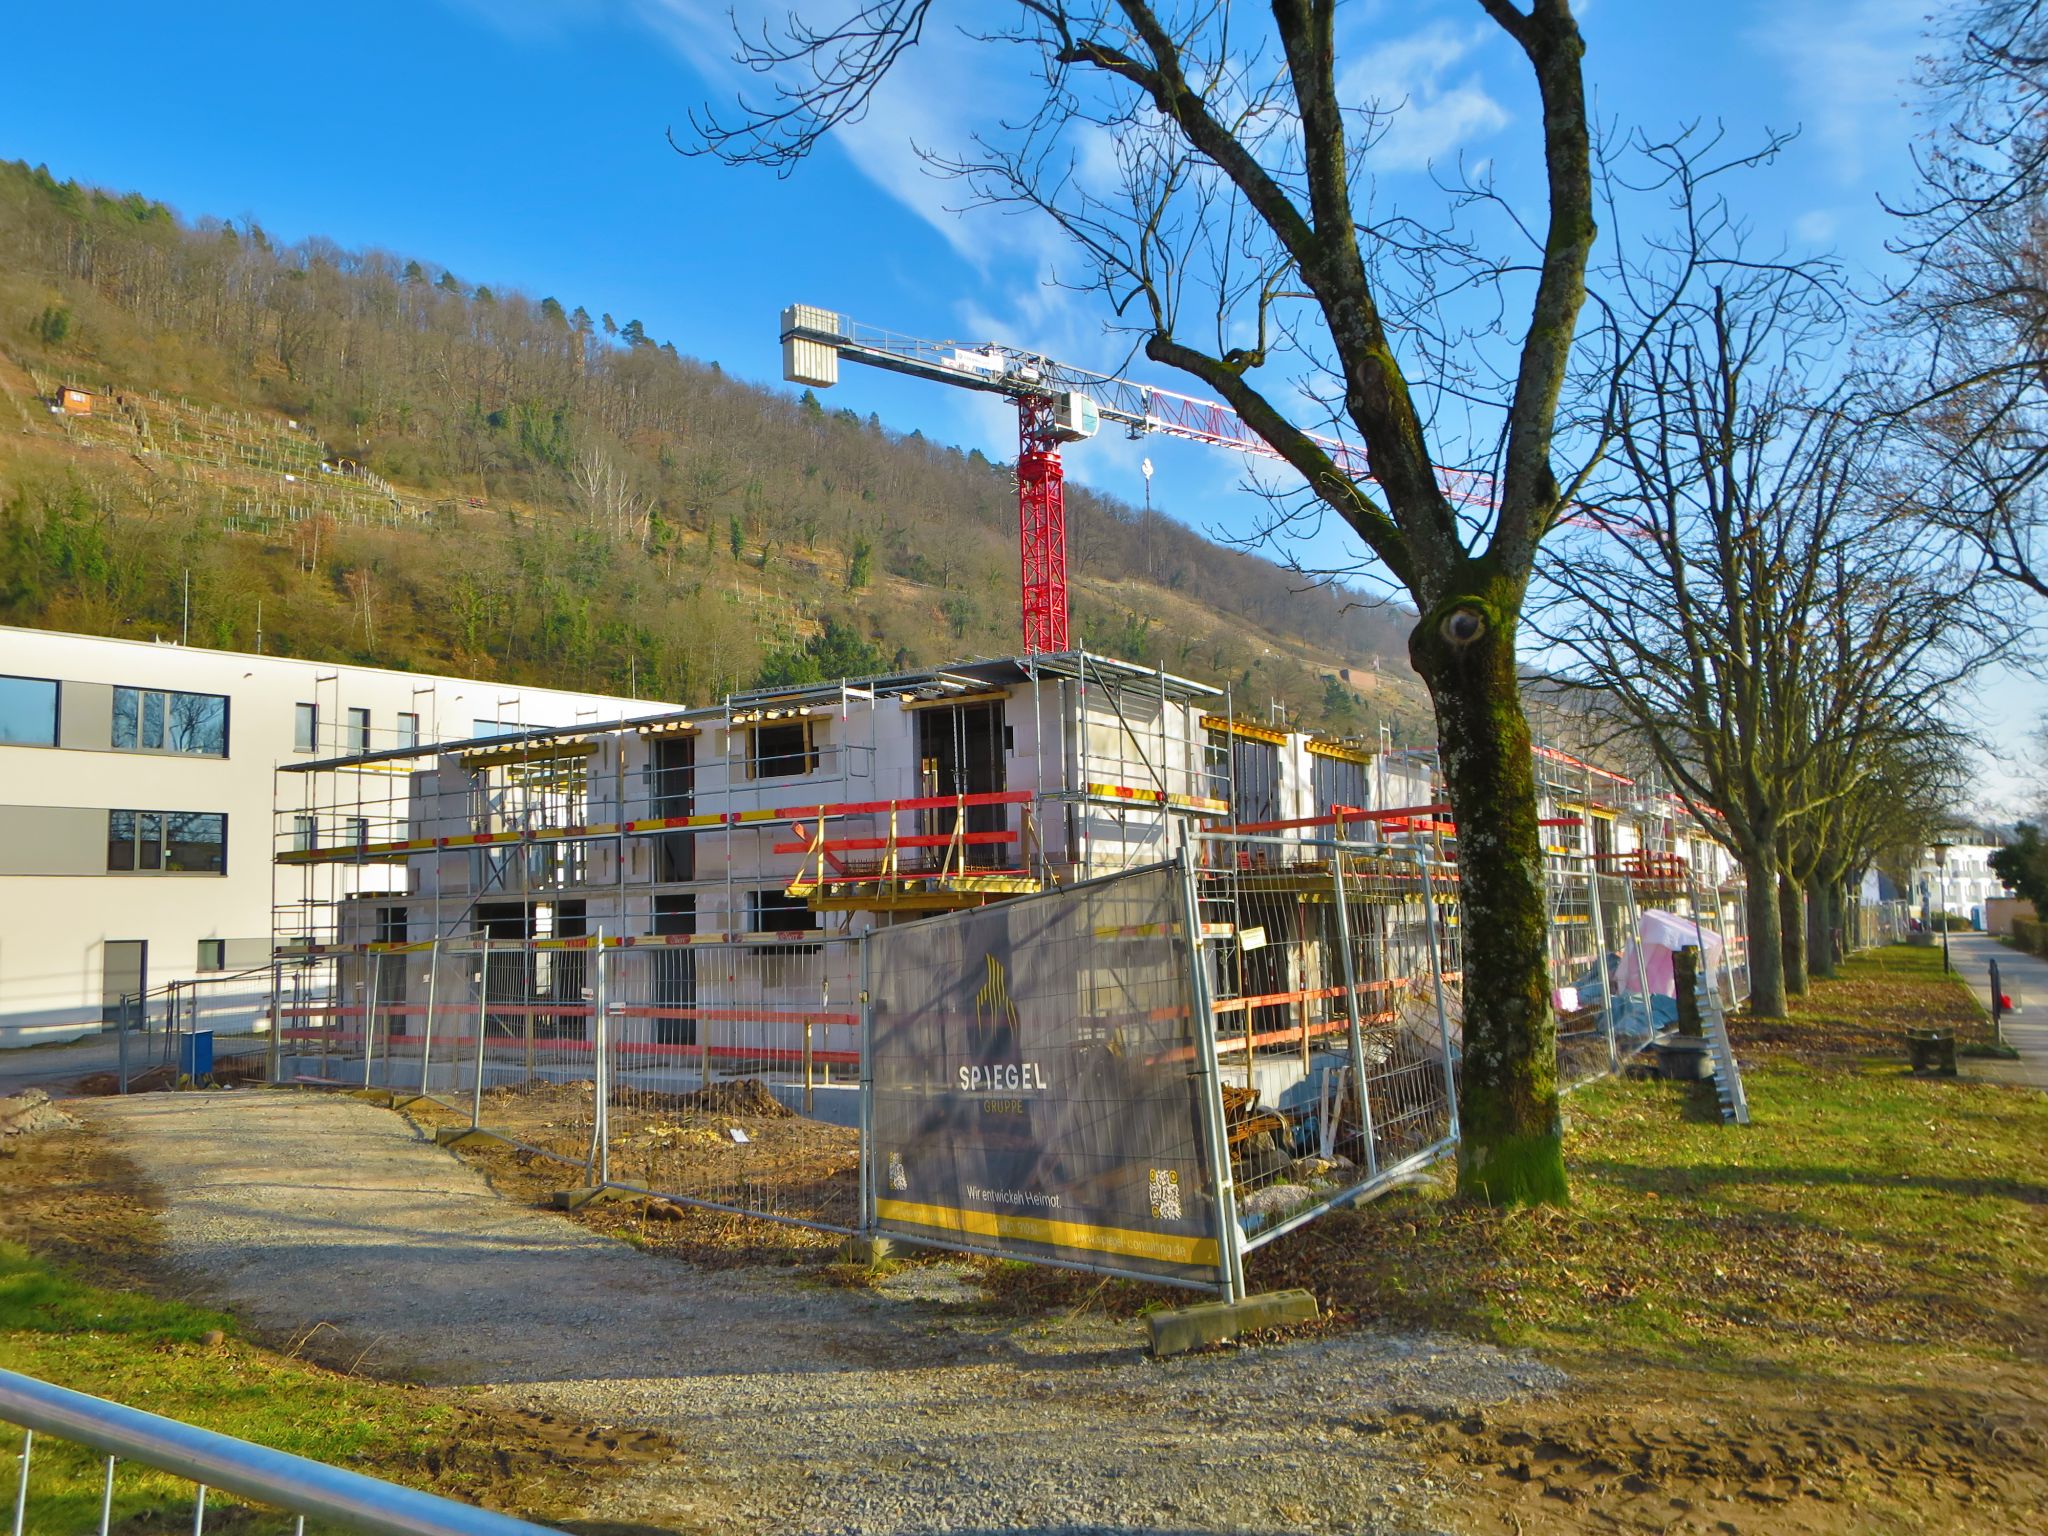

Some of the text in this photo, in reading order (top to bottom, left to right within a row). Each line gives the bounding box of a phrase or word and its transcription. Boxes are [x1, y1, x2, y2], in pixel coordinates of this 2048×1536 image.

[959, 1063, 1047, 1091] SPIEGEL
[984, 1100, 1024, 1114] GRUPPE
[966, 1185, 981, 1201] Wir
[1073, 1232, 1186, 1257] www.spiegel-consulting.de
